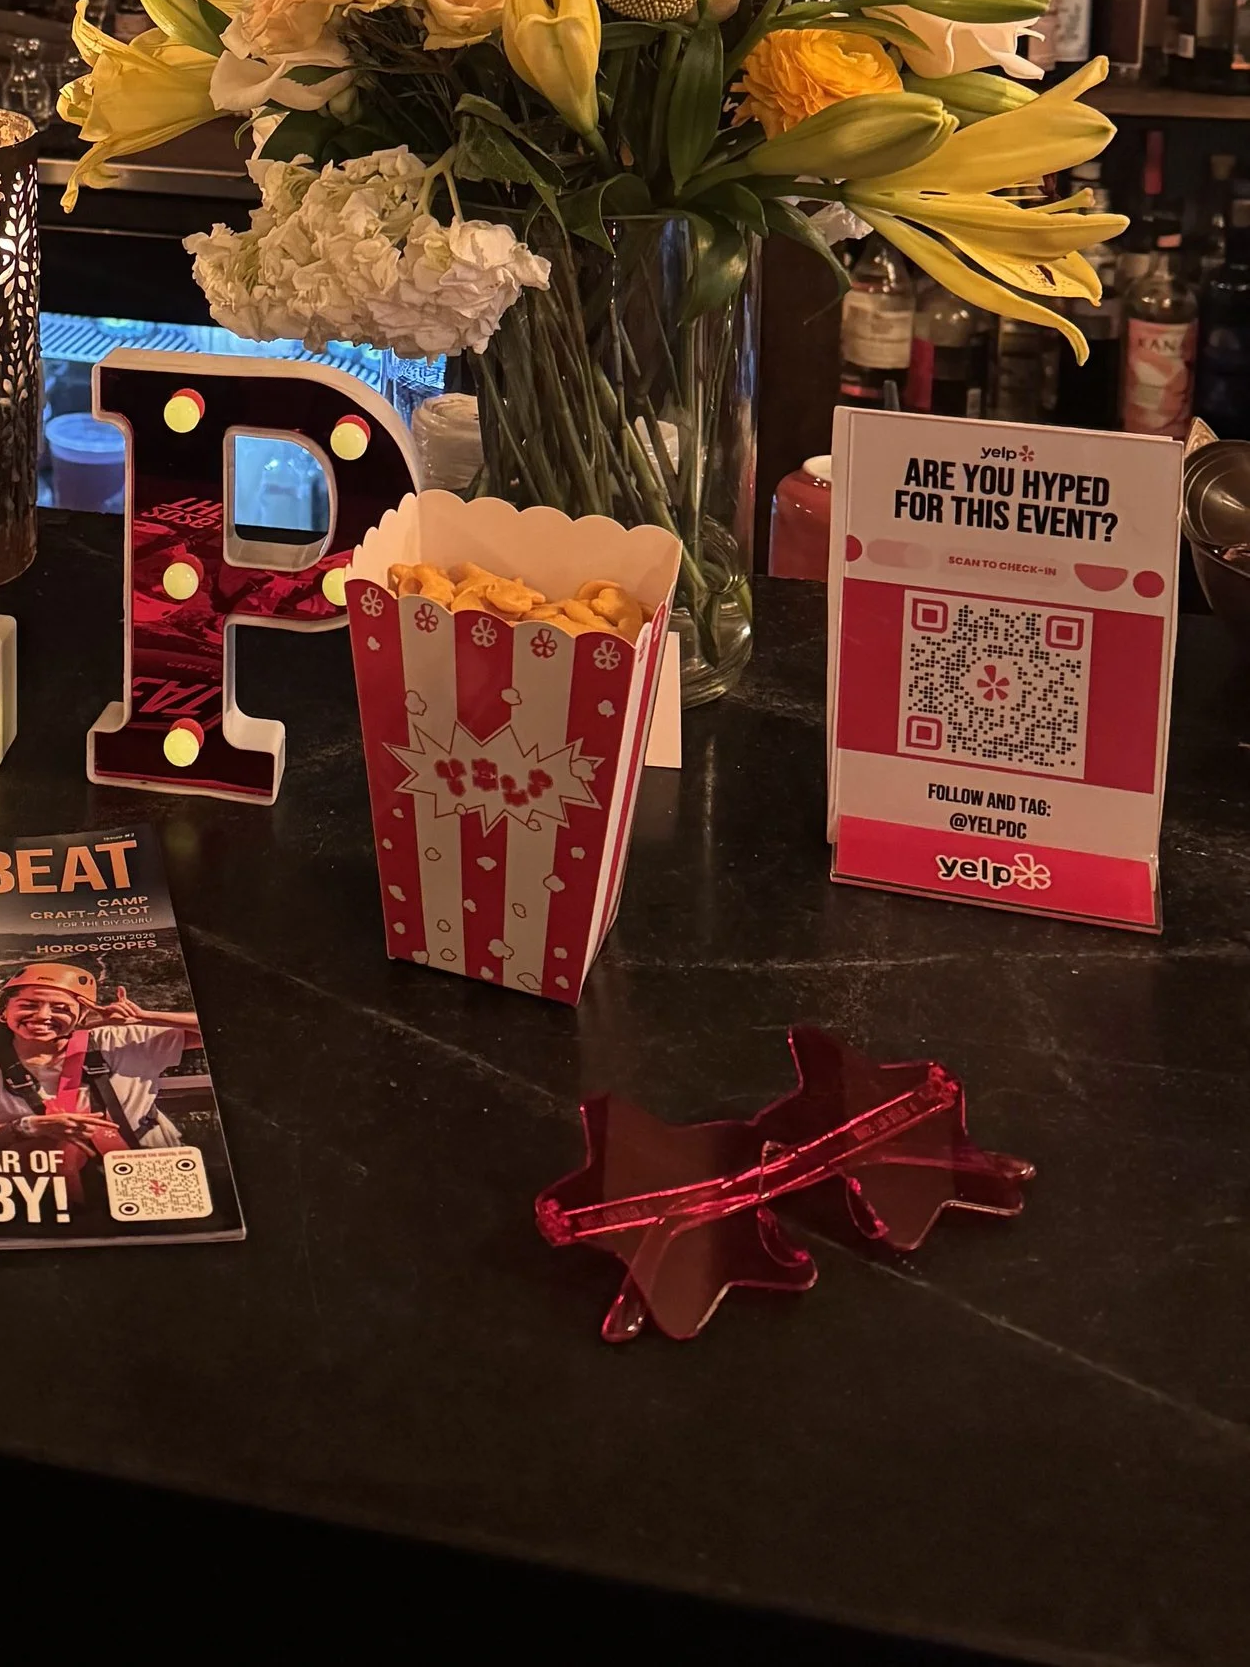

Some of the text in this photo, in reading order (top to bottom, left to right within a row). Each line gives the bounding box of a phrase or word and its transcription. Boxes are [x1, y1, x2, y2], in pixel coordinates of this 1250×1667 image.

[980, 446, 1018, 461] yelp
[904, 458, 1110, 507] ARE YOU HYPED
[894, 489, 1118, 542] FOR THIS EVENT?
[948, 556, 1057, 576] SCAN TO CHECK-IN
[928, 783, 1051, 817] FOLLOW AND TAG:
[949, 813, 1027, 839] @YELPDC
[937, 855, 1013, 889] yelp
[97, 896, 148, 907] CAMP
[30, 905, 150, 920] CRAFT-A-LOT
[122, 917, 153, 925] GURU
[35, 939, 157, 954] HOROSCOPES
[96, 933, 156, 942] YOUR 2026
[29, 1149, 64, 1174] OF
